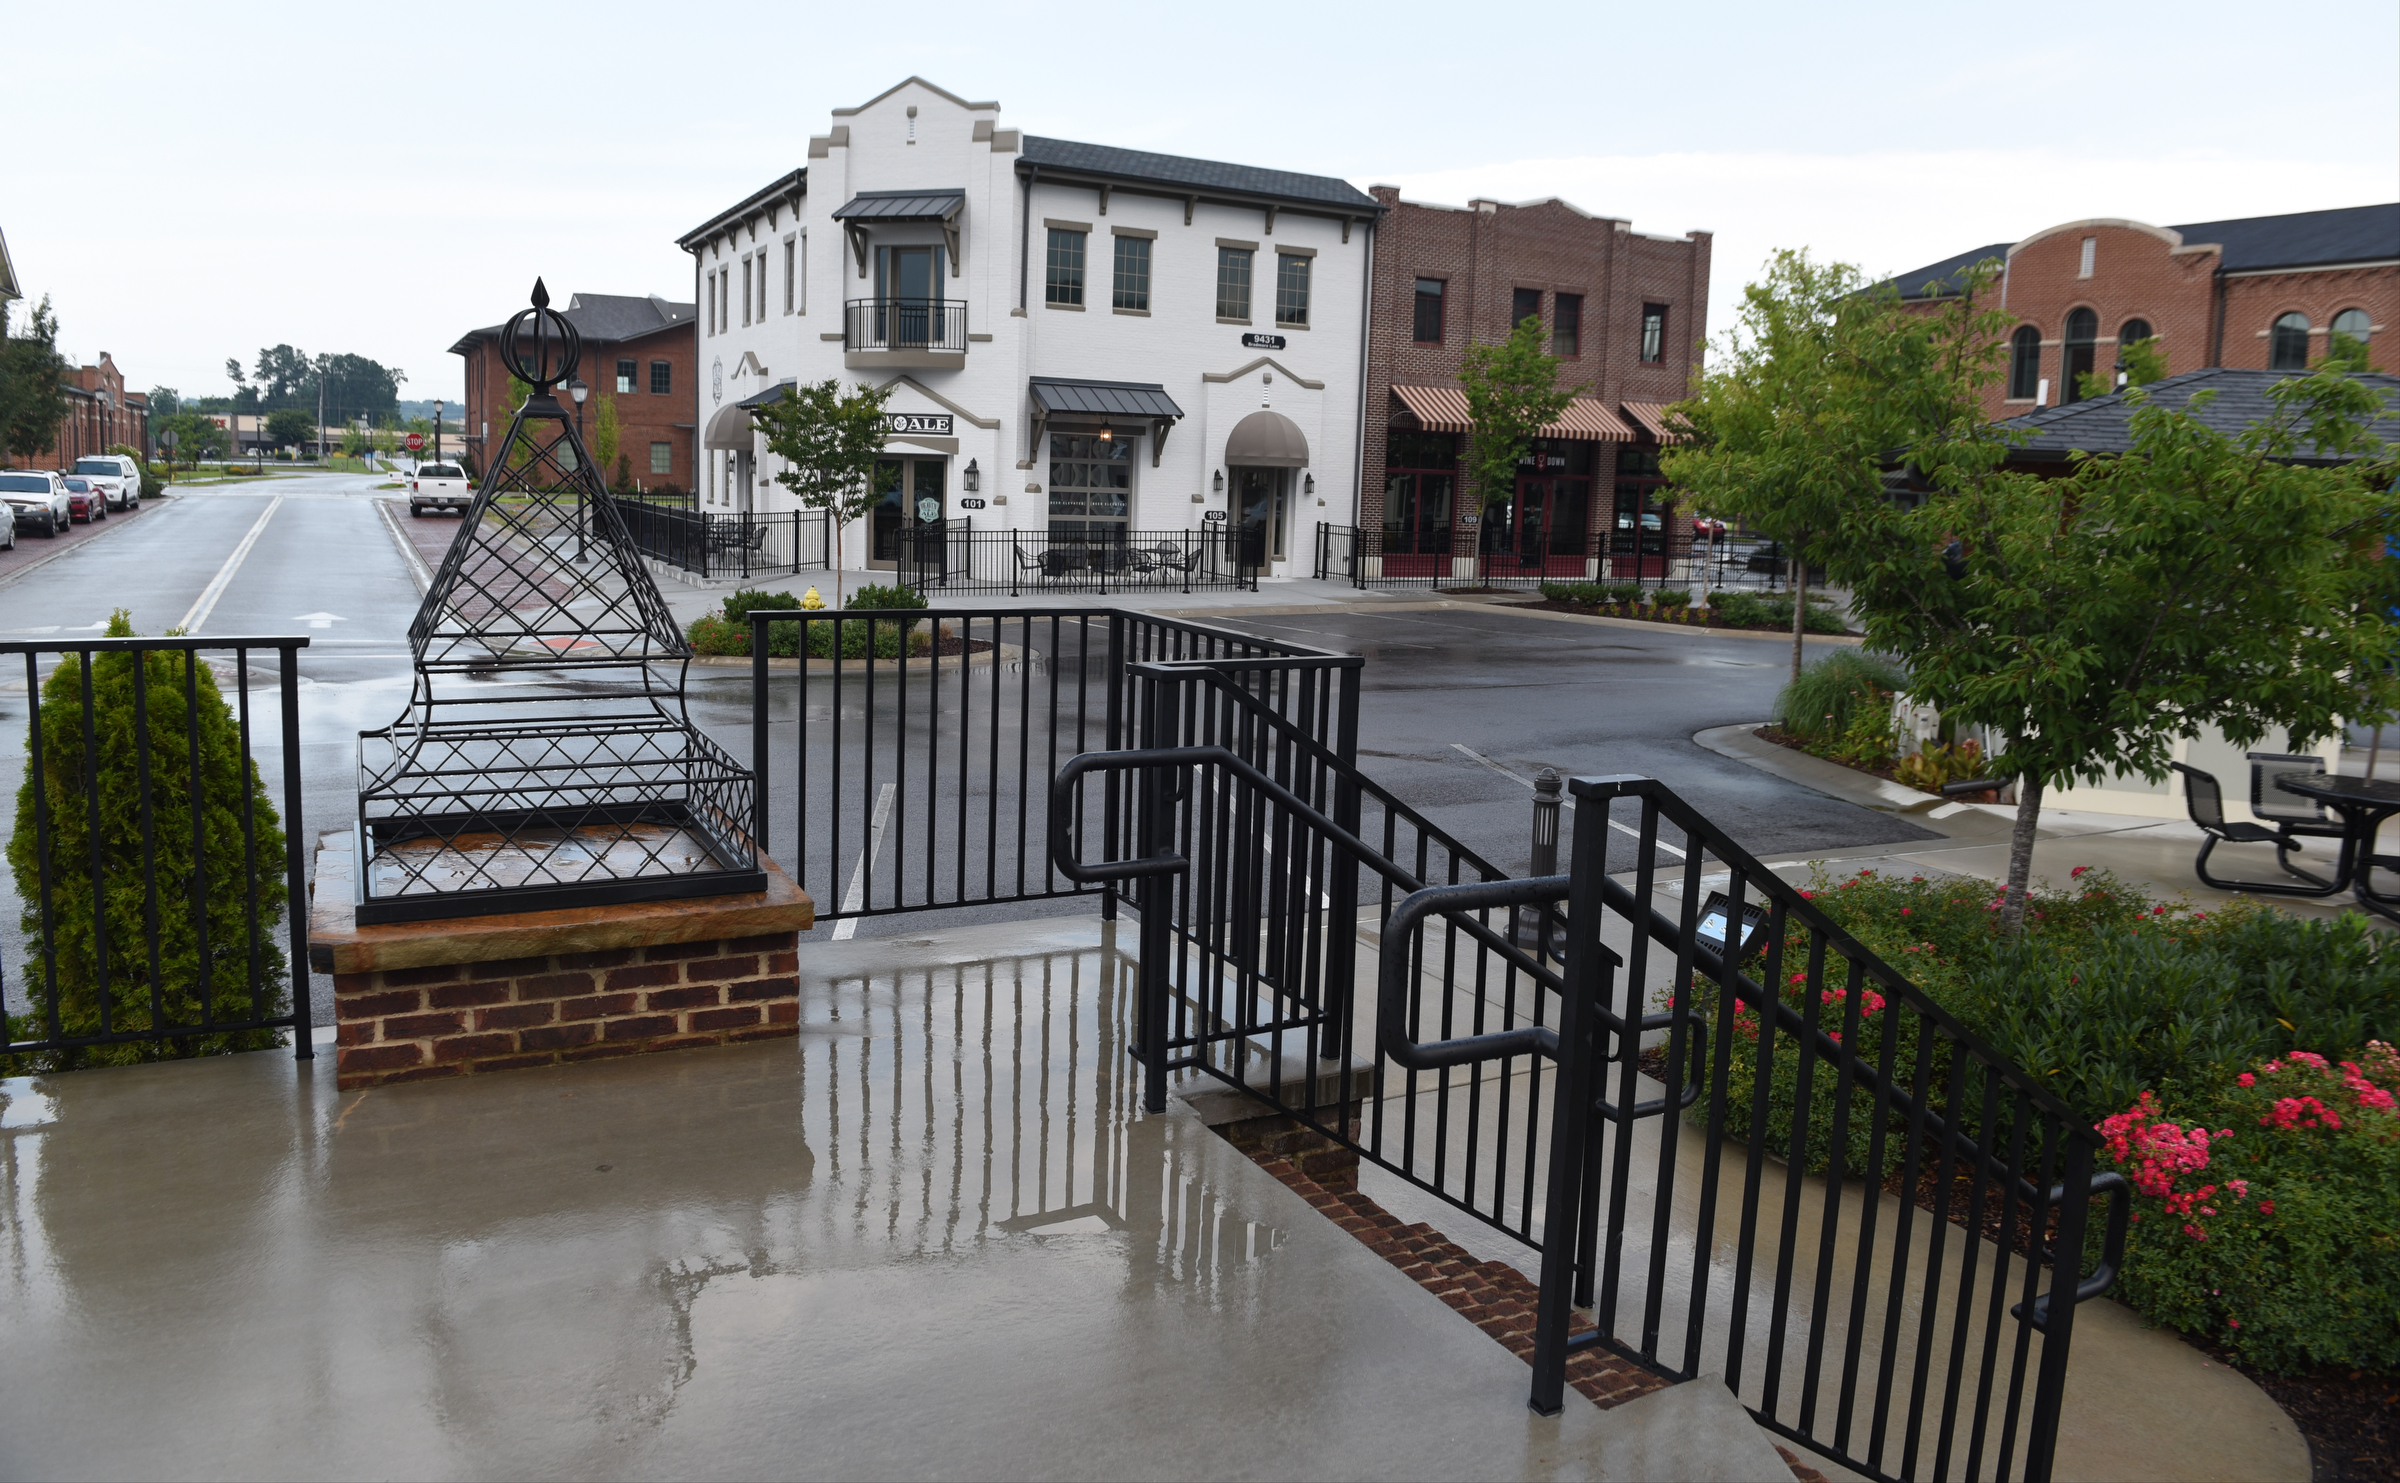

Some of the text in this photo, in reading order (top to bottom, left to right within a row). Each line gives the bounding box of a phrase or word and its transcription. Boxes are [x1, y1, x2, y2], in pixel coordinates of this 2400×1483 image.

[1254, 334, 1275, 344] 9431
[907, 418, 950, 430] ALE
[406, 438, 422, 446] STOP
[1546, 456, 1566, 466] DOWN
[964, 500, 982, 508] 101
[1208, 512, 1224, 520] 105
[1464, 516, 1478, 524] 109
